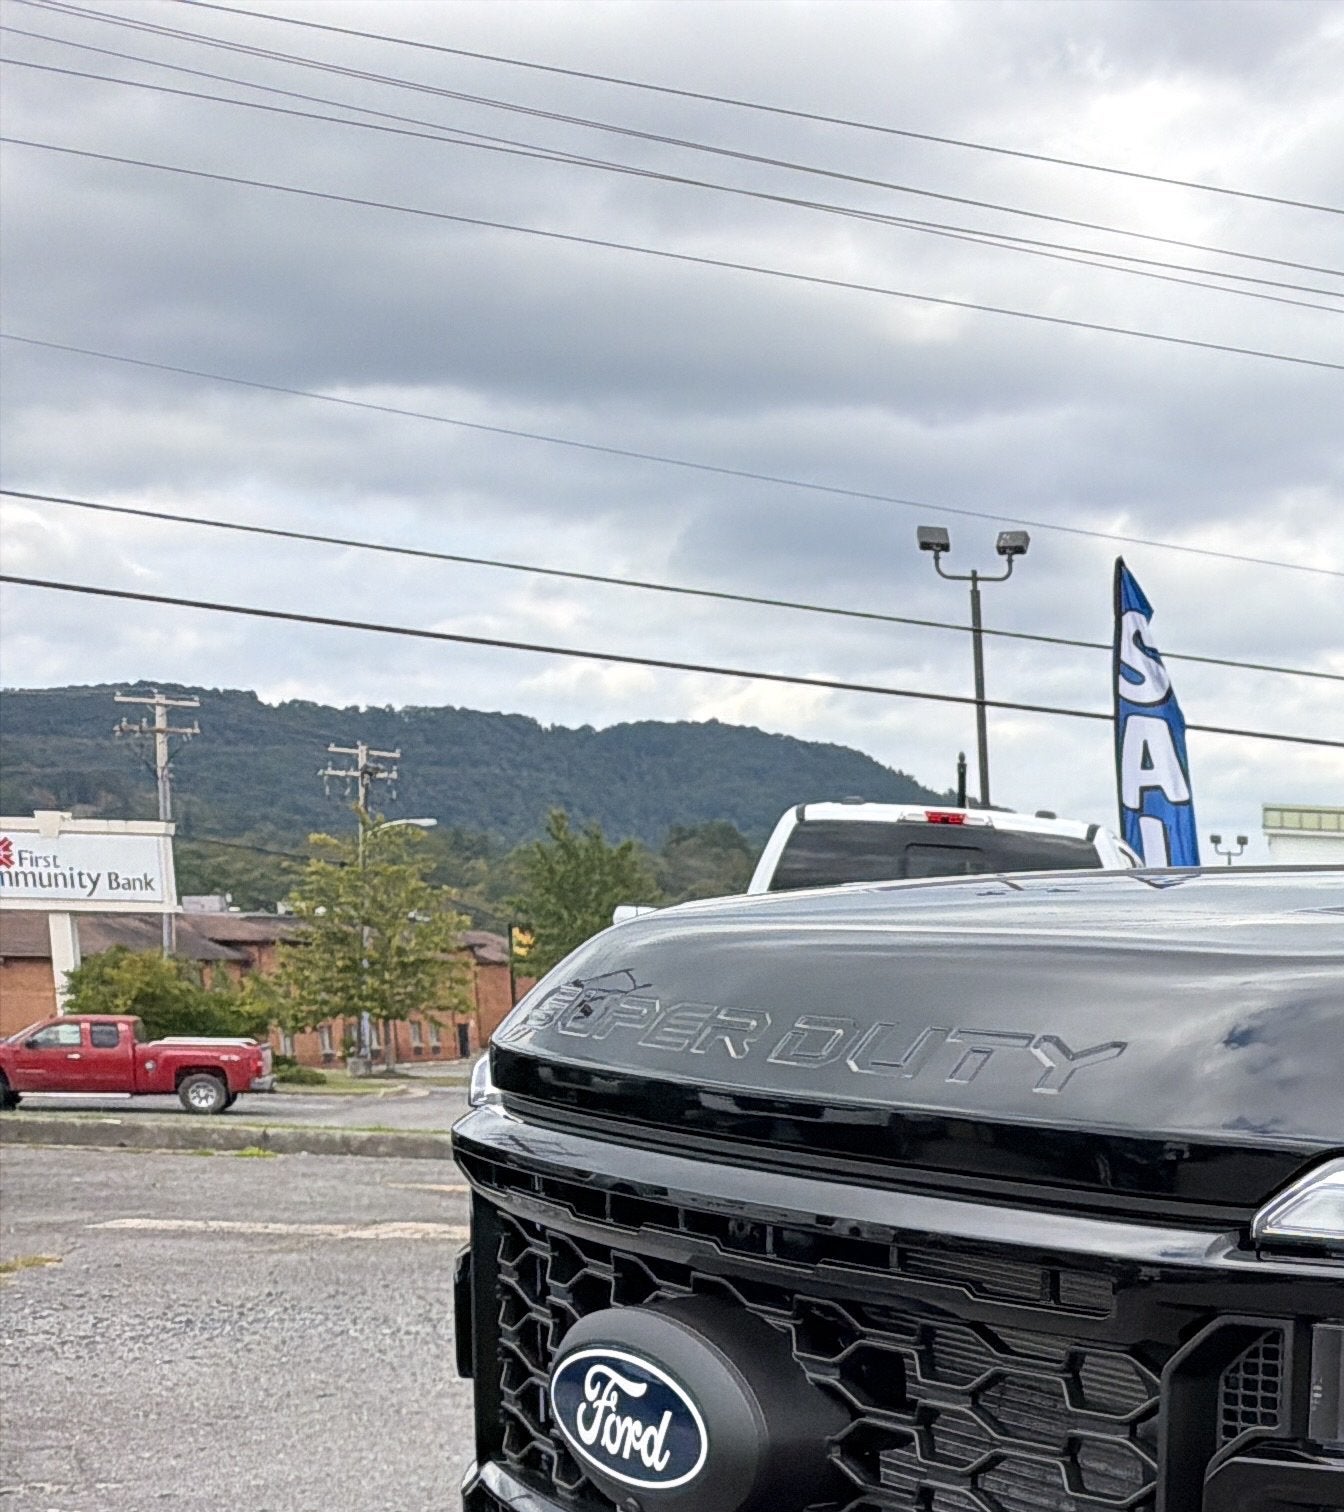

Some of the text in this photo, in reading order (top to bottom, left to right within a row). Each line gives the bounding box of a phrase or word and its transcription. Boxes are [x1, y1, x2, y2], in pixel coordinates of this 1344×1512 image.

[18, 849, 61, 868] First
[107, 871, 156, 892] Bank
[766, 1013, 1129, 1095] DUTY
[575, 1363, 673, 1472] Ford
